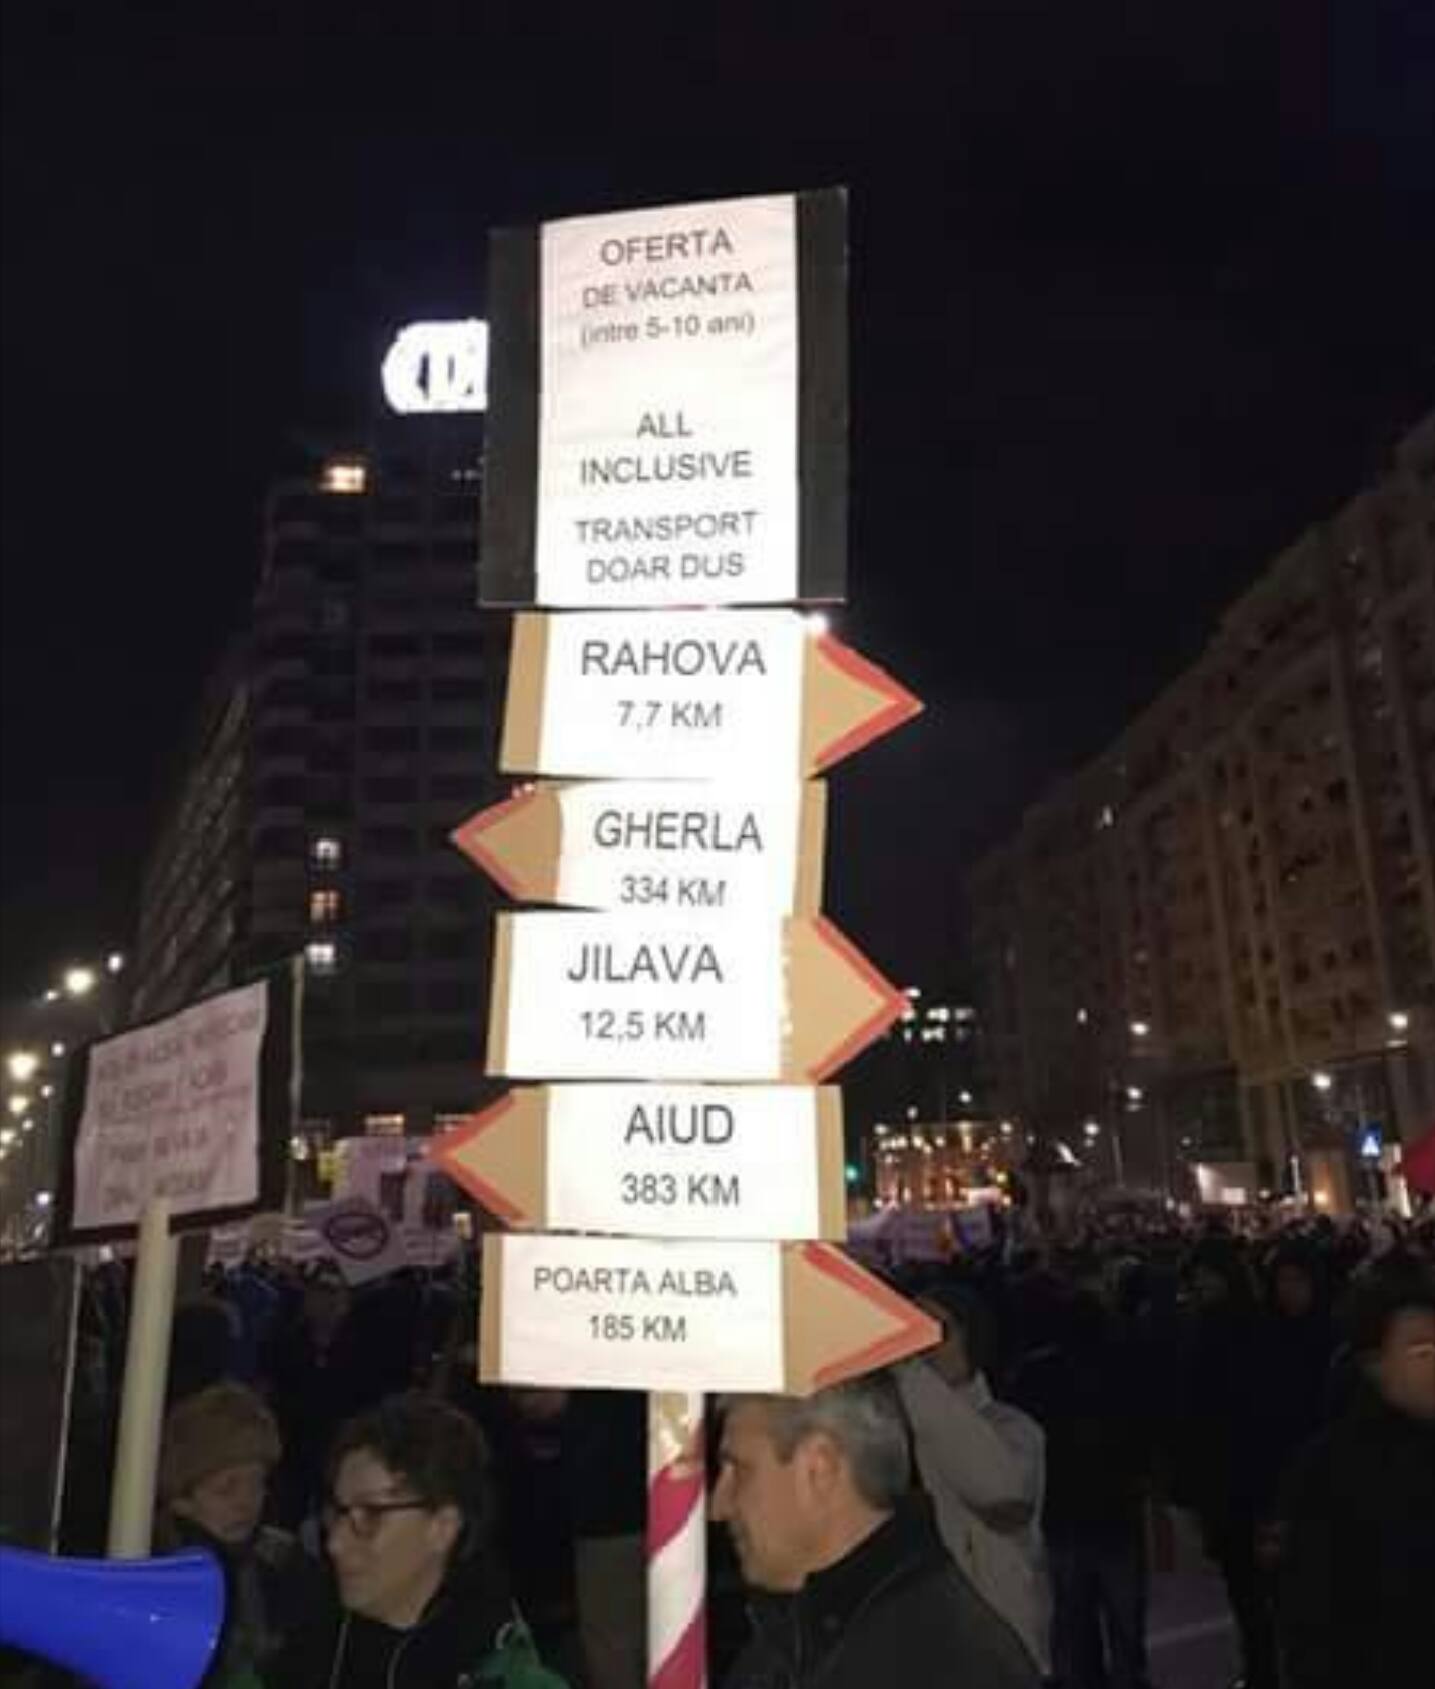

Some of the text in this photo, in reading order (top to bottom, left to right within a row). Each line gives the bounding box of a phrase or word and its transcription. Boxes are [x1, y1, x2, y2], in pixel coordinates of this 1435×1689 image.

[600, 229, 734, 265] OFERTA
[582, 272, 754, 310] DE VACANTA
[645, 314, 701, 339] 5-10
[707, 311, 755, 336] ani)
[636, 411, 693, 439] ALL
[580, 450, 752, 485] INCLUSIVE
[574, 510, 759, 543] TRANSPORT
[587, 551, 745, 584] DOAR DUS
[582, 640, 767, 676] RAHOVA
[618, 700, 723, 730] 7,7 KM
[594, 809, 763, 852] GHERLA
[621, 875, 726, 906] 334 KM
[567, 944, 723, 983] JILAVA
[582, 1010, 705, 1042] 12,5 KM
[624, 1104, 734, 1145] AIUD
[622, 1172, 739, 1206] 383 KM
[534, 1266, 738, 1297] POARTA ALBA
[590, 1313, 686, 1342] 185 KM
